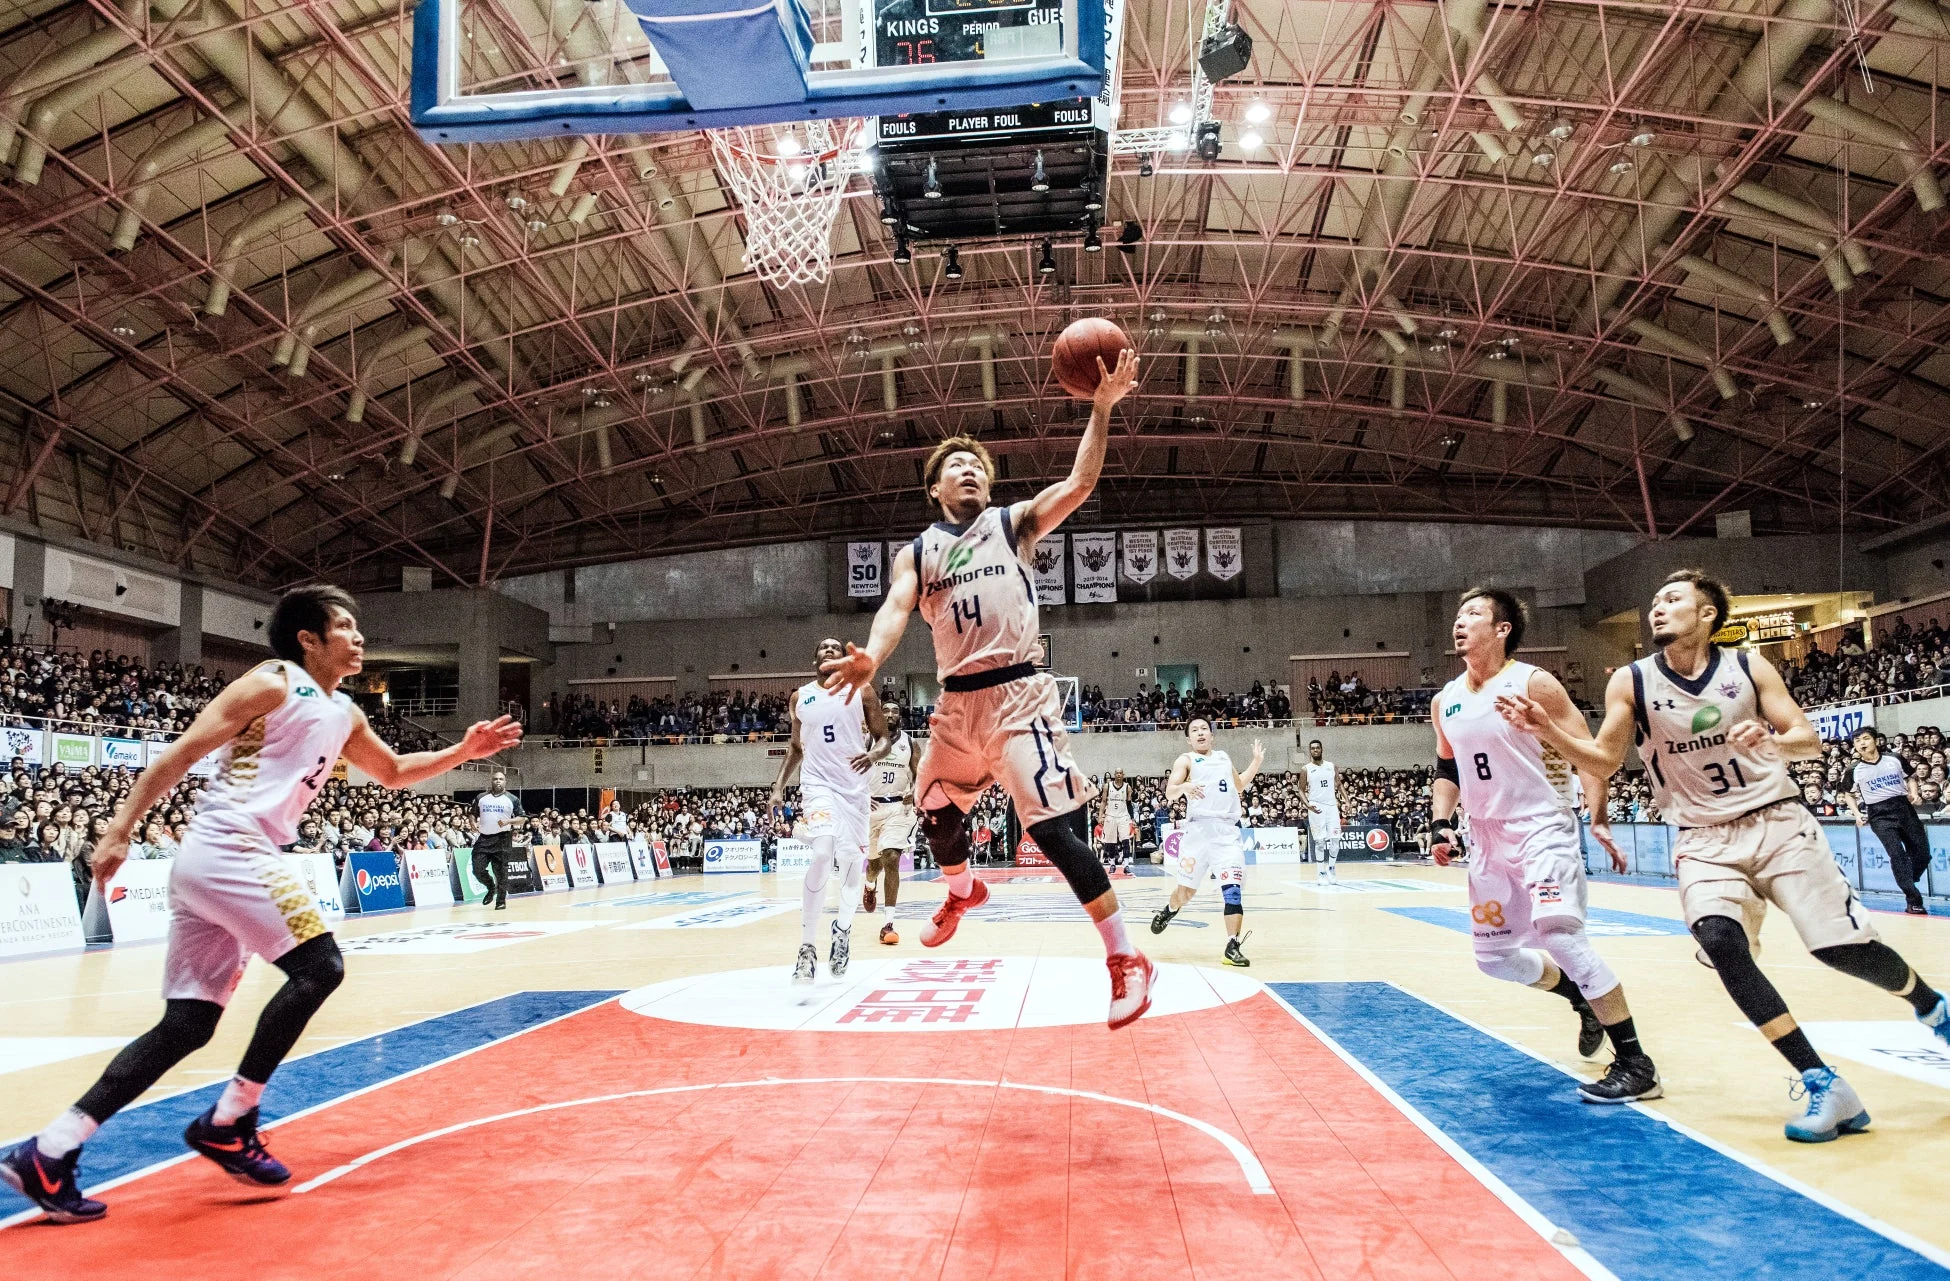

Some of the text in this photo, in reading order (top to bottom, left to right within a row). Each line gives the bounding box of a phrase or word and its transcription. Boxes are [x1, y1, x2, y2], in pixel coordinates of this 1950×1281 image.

[887, 18, 939, 37] KINGS
[949, 115, 1021, 130] PLAYER FOUL
[1054, 109, 1088, 122] FOULS
[883, 122, 916, 136] FOULS
[852, 564, 877, 580] 50
[951, 595, 982, 634] 14
[823, 725, 836, 743] 5
[1665, 732, 1729, 754] Zenho
[1474, 752, 1492, 781] 8
[882, 772, 895, 784] 30
[1320, 780, 1328, 788] 12
[1703, 758, 1746, 795] 31
[1866, 774, 1900, 785] TURKISH
[1219, 779, 1228, 792] 9
[372, 871, 400, 891] pepsi
[18, 903, 40, 916] ANA
[318, 897, 340, 912] ホーム
